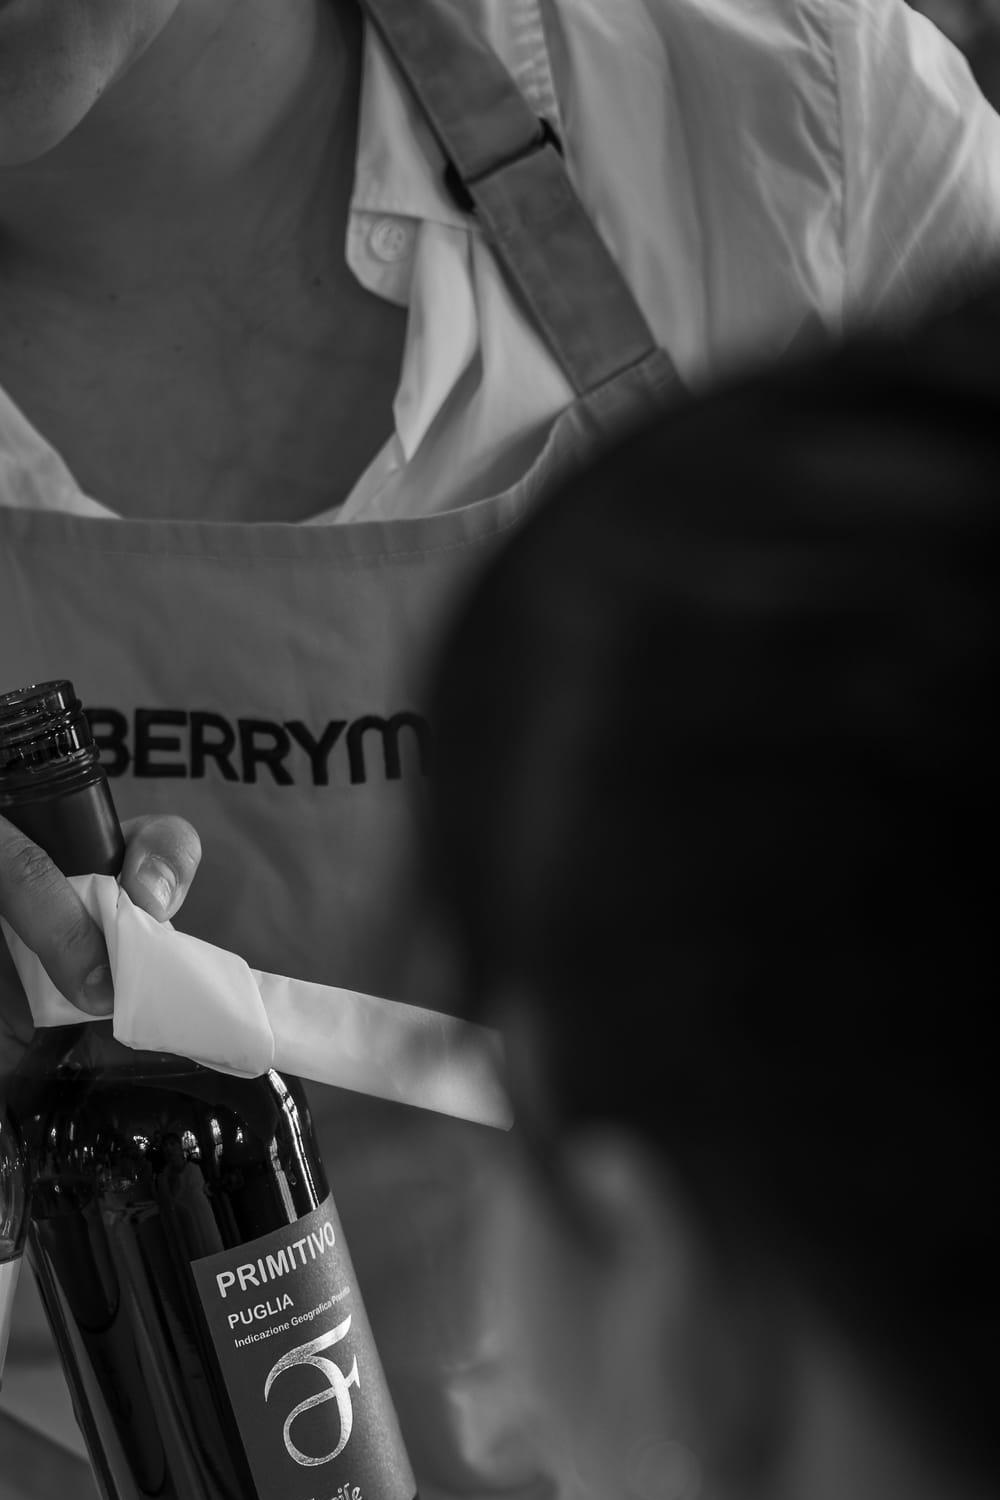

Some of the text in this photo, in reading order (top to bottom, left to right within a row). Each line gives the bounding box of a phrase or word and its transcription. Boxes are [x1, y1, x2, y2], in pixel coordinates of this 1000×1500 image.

[216, 1221, 336, 1299] PRIMITIVO
[227, 1293, 295, 1329] PUGLIA
[234, 1322, 290, 1349] Indicazione
[290, 1301, 332, 1327] Geografica
